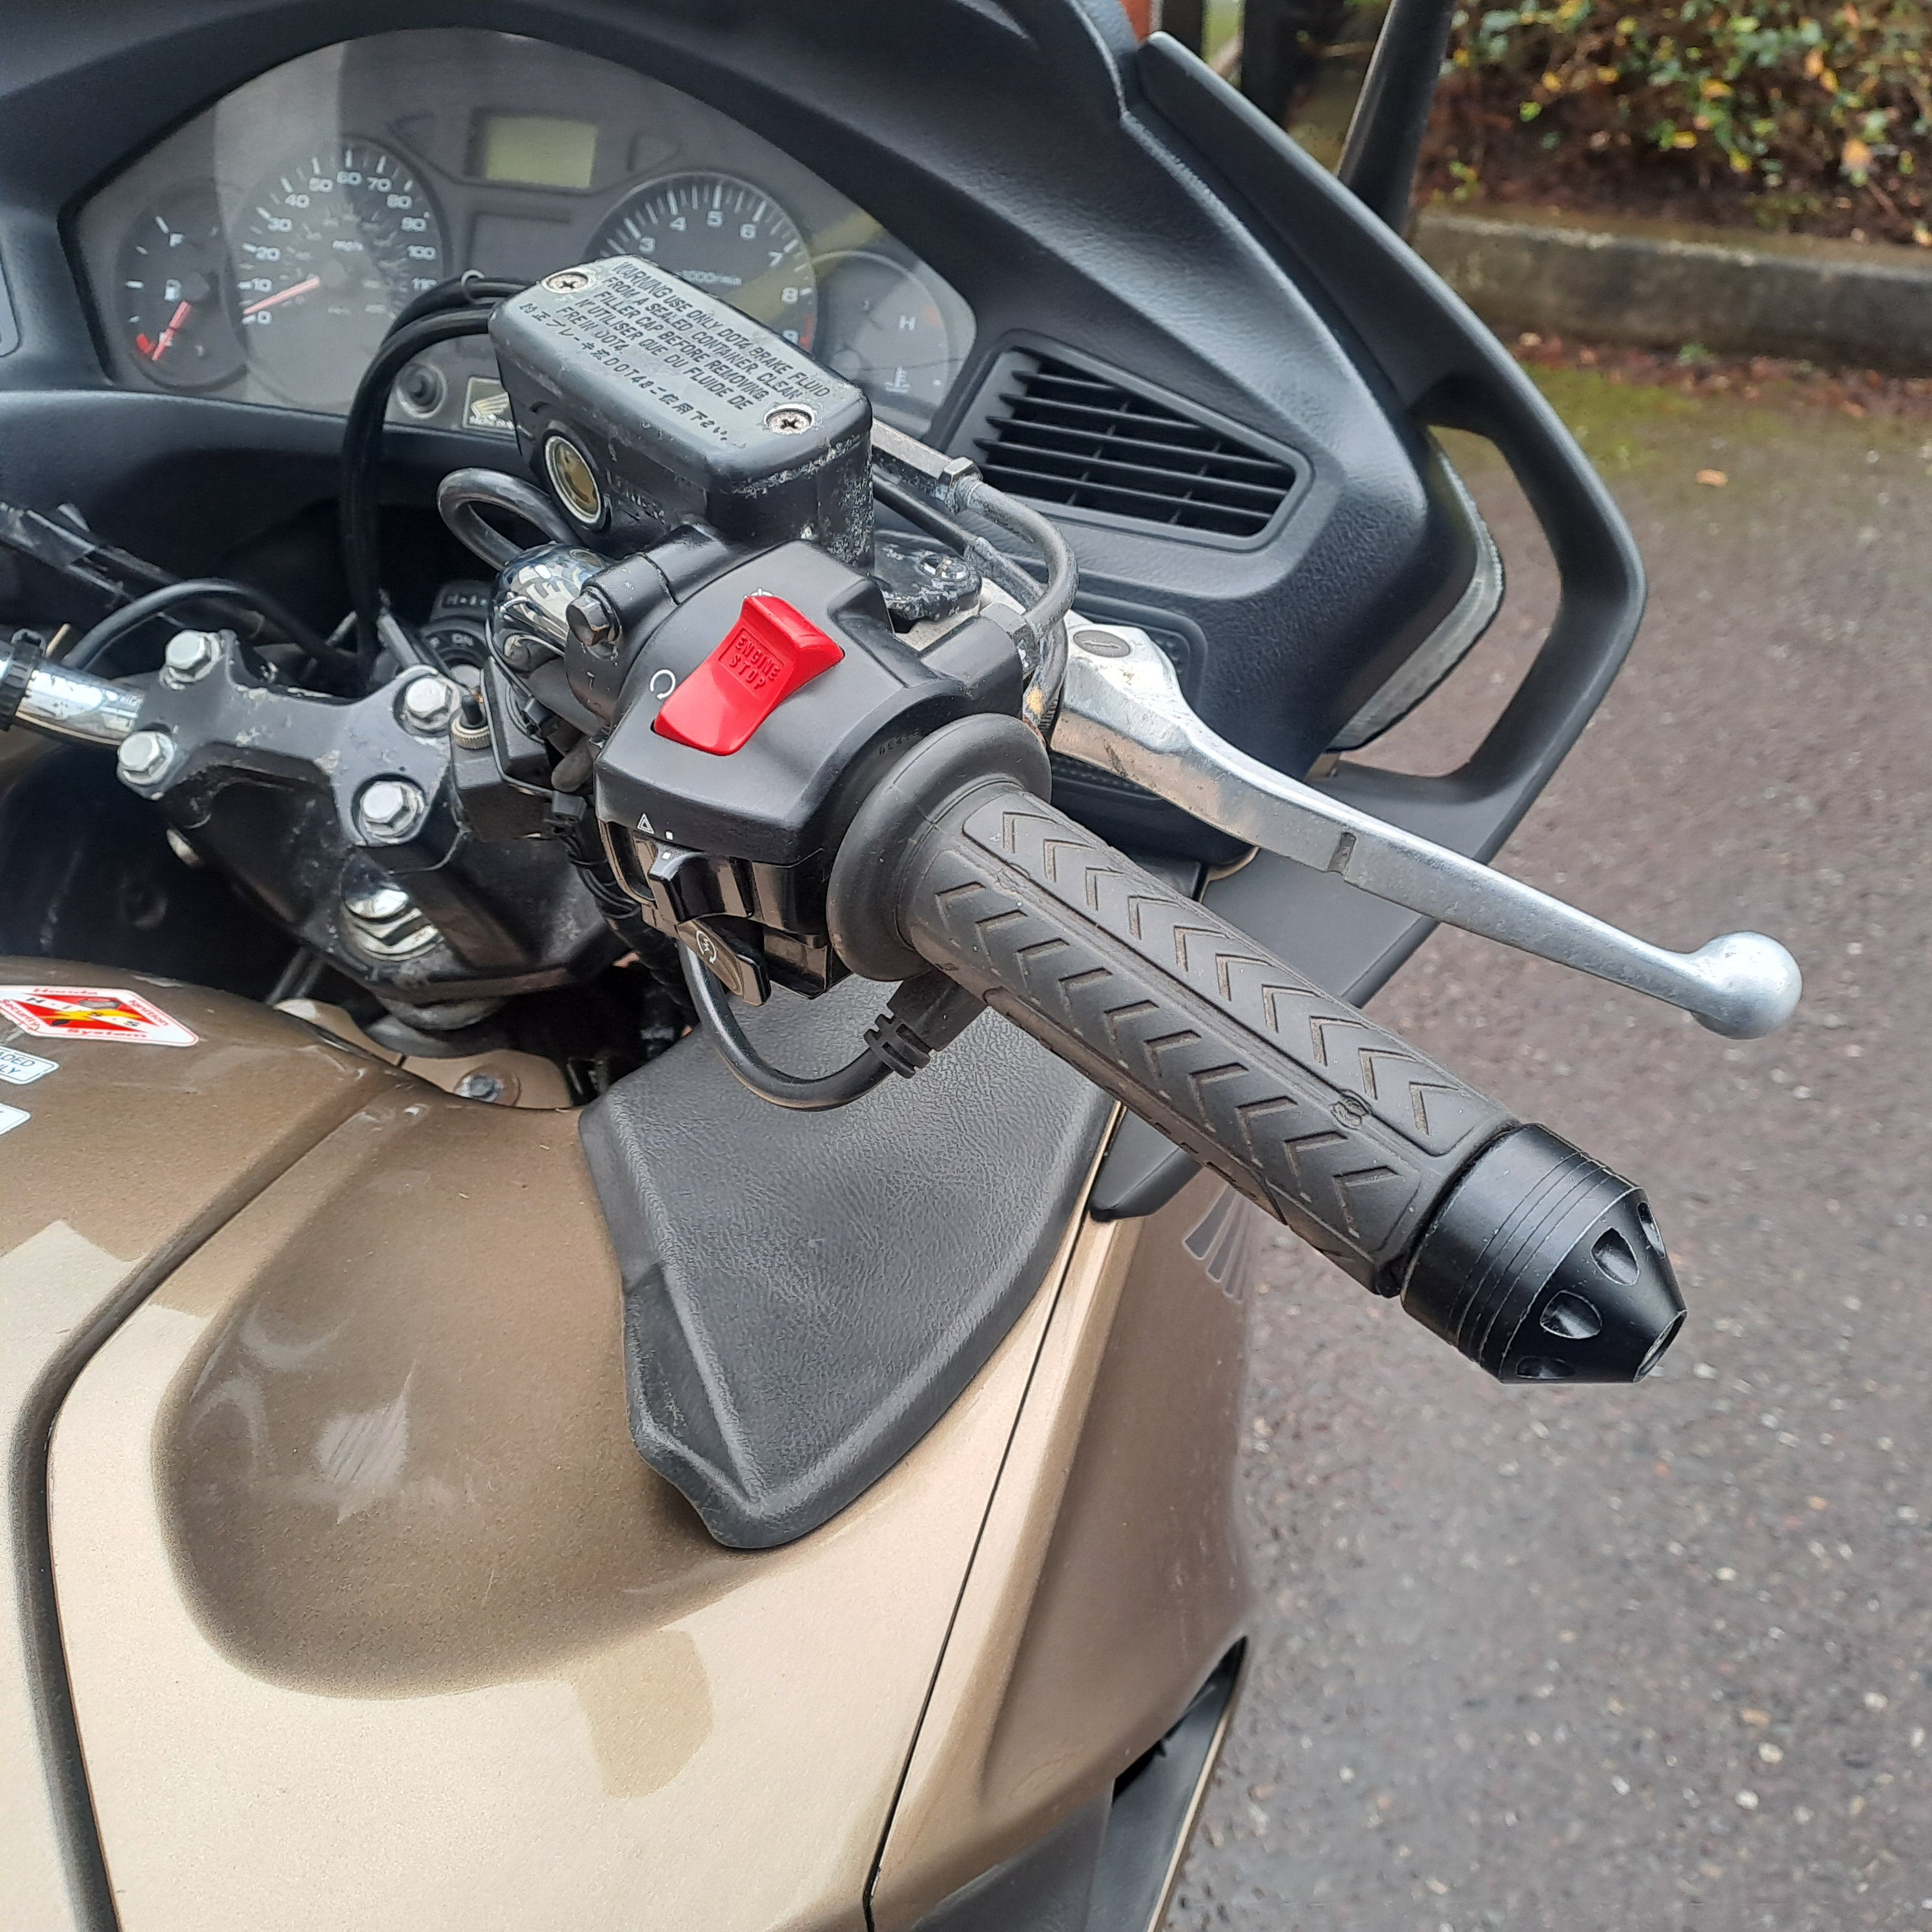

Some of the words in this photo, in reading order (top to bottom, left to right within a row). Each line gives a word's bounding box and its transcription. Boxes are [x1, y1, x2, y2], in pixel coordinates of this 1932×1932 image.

[366, 176, 392, 192] 70
[283, 193, 310, 209] 40
[669, 216, 686, 231] 4
[706, 210, 724, 227] 5
[740, 223, 757, 240] 6
[256, 245, 280, 261] 20
[407, 244, 437, 261] 100
[768, 251, 783, 267] 7
[252, 277, 272, 293] 10
[781, 287, 799, 304] 8
[555, 306, 601, 331] FREIN
[899, 315, 916, 331] H
[602, 276, 641, 298] FROM
[644, 303, 696, 333] SEALED
[690, 331, 759, 375] CONTAINER.
[756, 373, 805, 400] CLEAN
[611, 262, 673, 298] WARNING
[663, 294, 694, 313] USE
[686, 310, 723, 331] ONLY
[716, 328, 755, 350] DOT4
[746, 346, 794, 375] BRAKE
[786, 372, 832, 397] FLUID
[575, 298, 644, 341] N'UTILISER
[637, 338, 669, 356] QUE
[663, 354, 689, 370] DU
[682, 367, 734, 398] FLUIDE
[727, 395, 754, 410] DE
[593, 291, 641, 319] FILLER
[635, 316, 667, 331] CAP
[657, 331, 712, 363] BEFORE
[704, 359, 769, 402] REMOVING.
[735, 635, 781, 681] ENGINE
[728, 653, 766, 690] STOP
